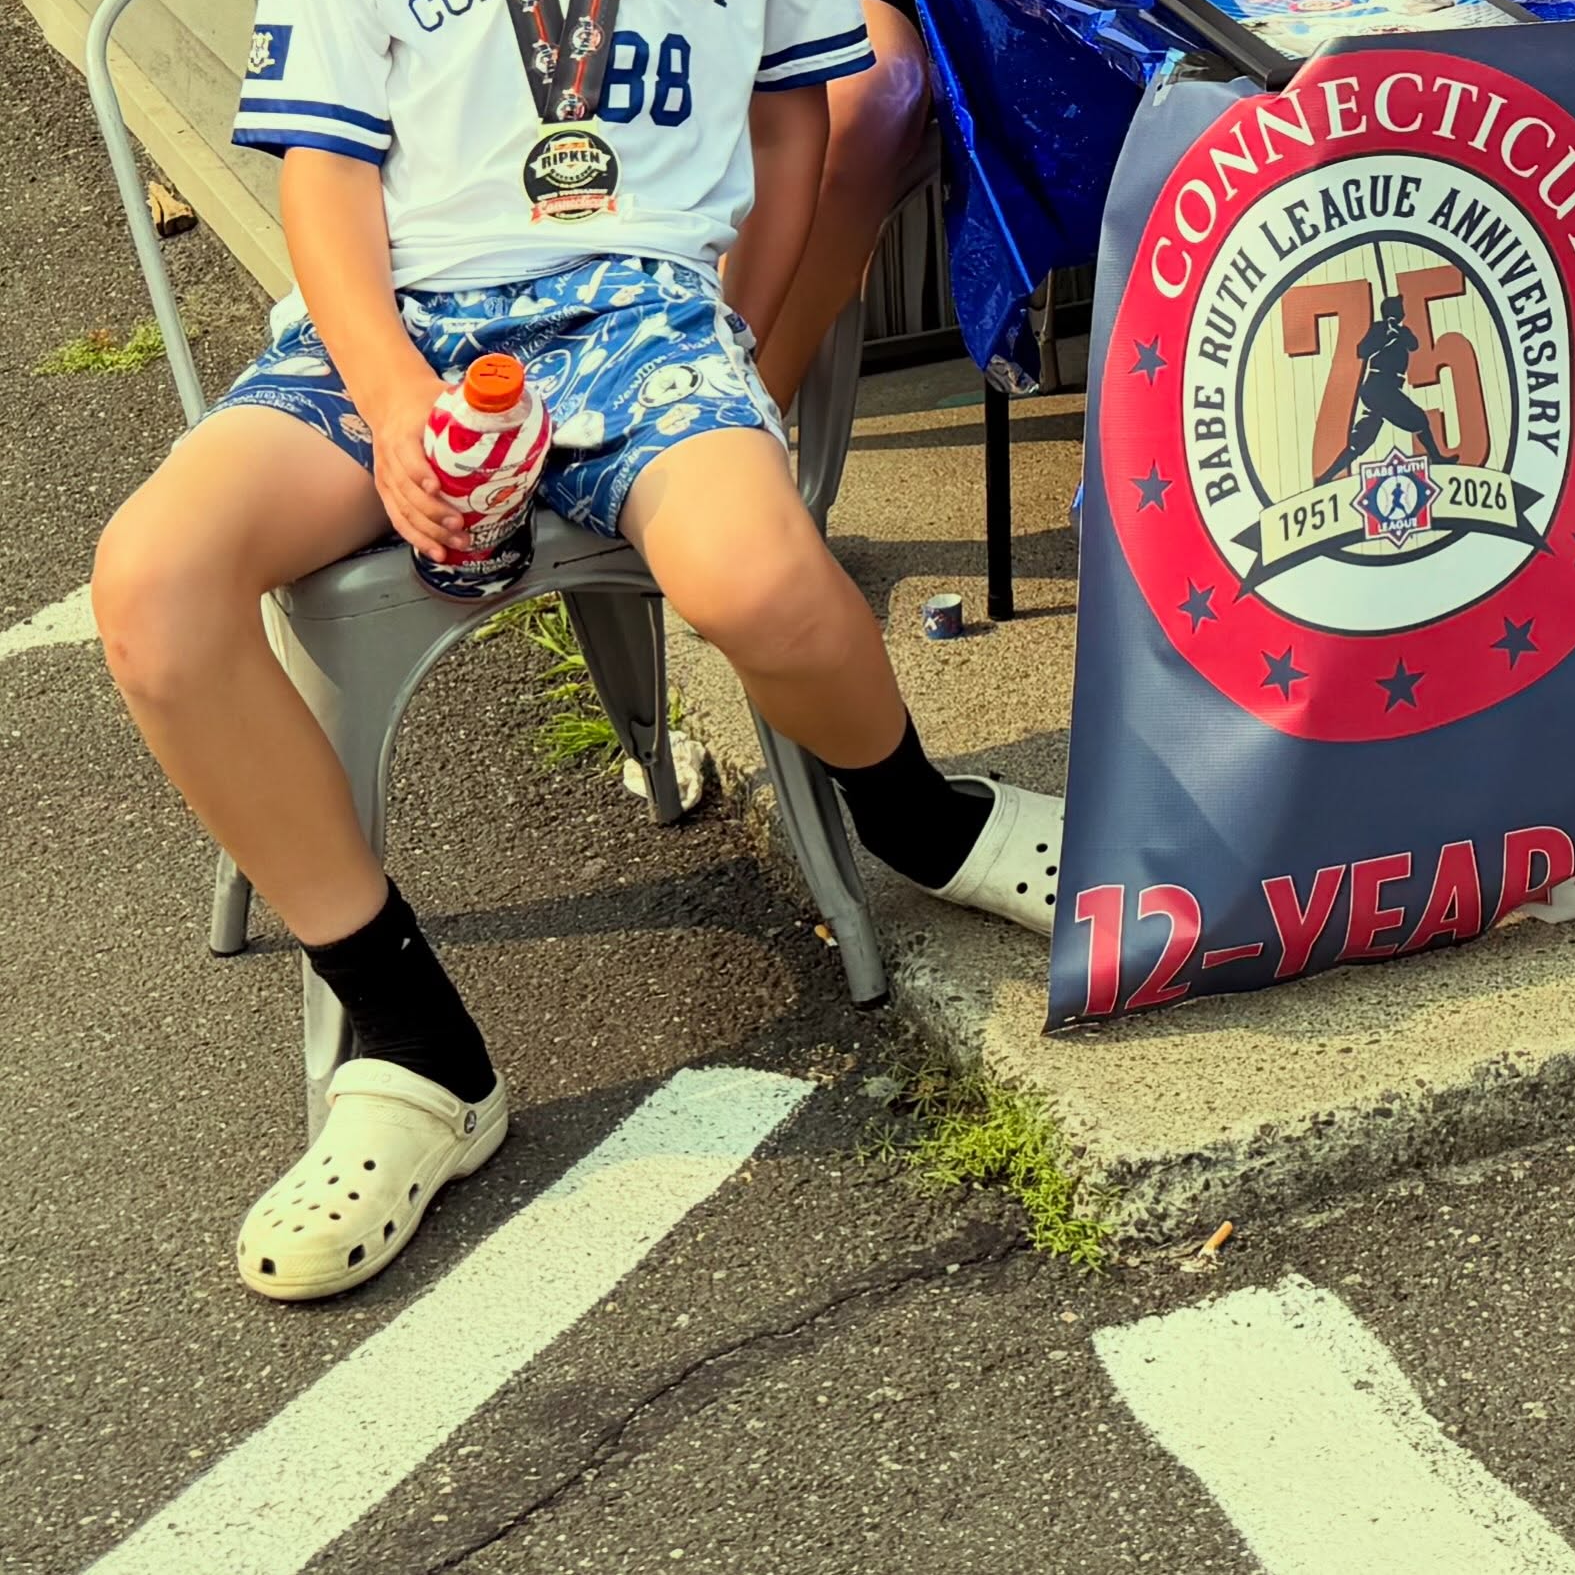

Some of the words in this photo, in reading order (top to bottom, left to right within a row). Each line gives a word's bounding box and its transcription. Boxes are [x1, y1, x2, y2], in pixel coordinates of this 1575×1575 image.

[597, 30, 693, 127] 88
[541, 150, 601, 170] RIPKEN
[1265, 174, 1423, 262] LEAGUE
[1202, 254, 1268, 382] RUTH
[1428, 185, 1562, 459] ANNIVERSARY
[1280, 265, 1492, 483] 75
[1193, 385, 1239, 507] BABE
[1365, 466, 1394, 478] BABE
[1396, 461, 1425, 474] RUTH
[1277, 492, 1343, 542] 1951
[1448, 475, 1509, 512] 2026
